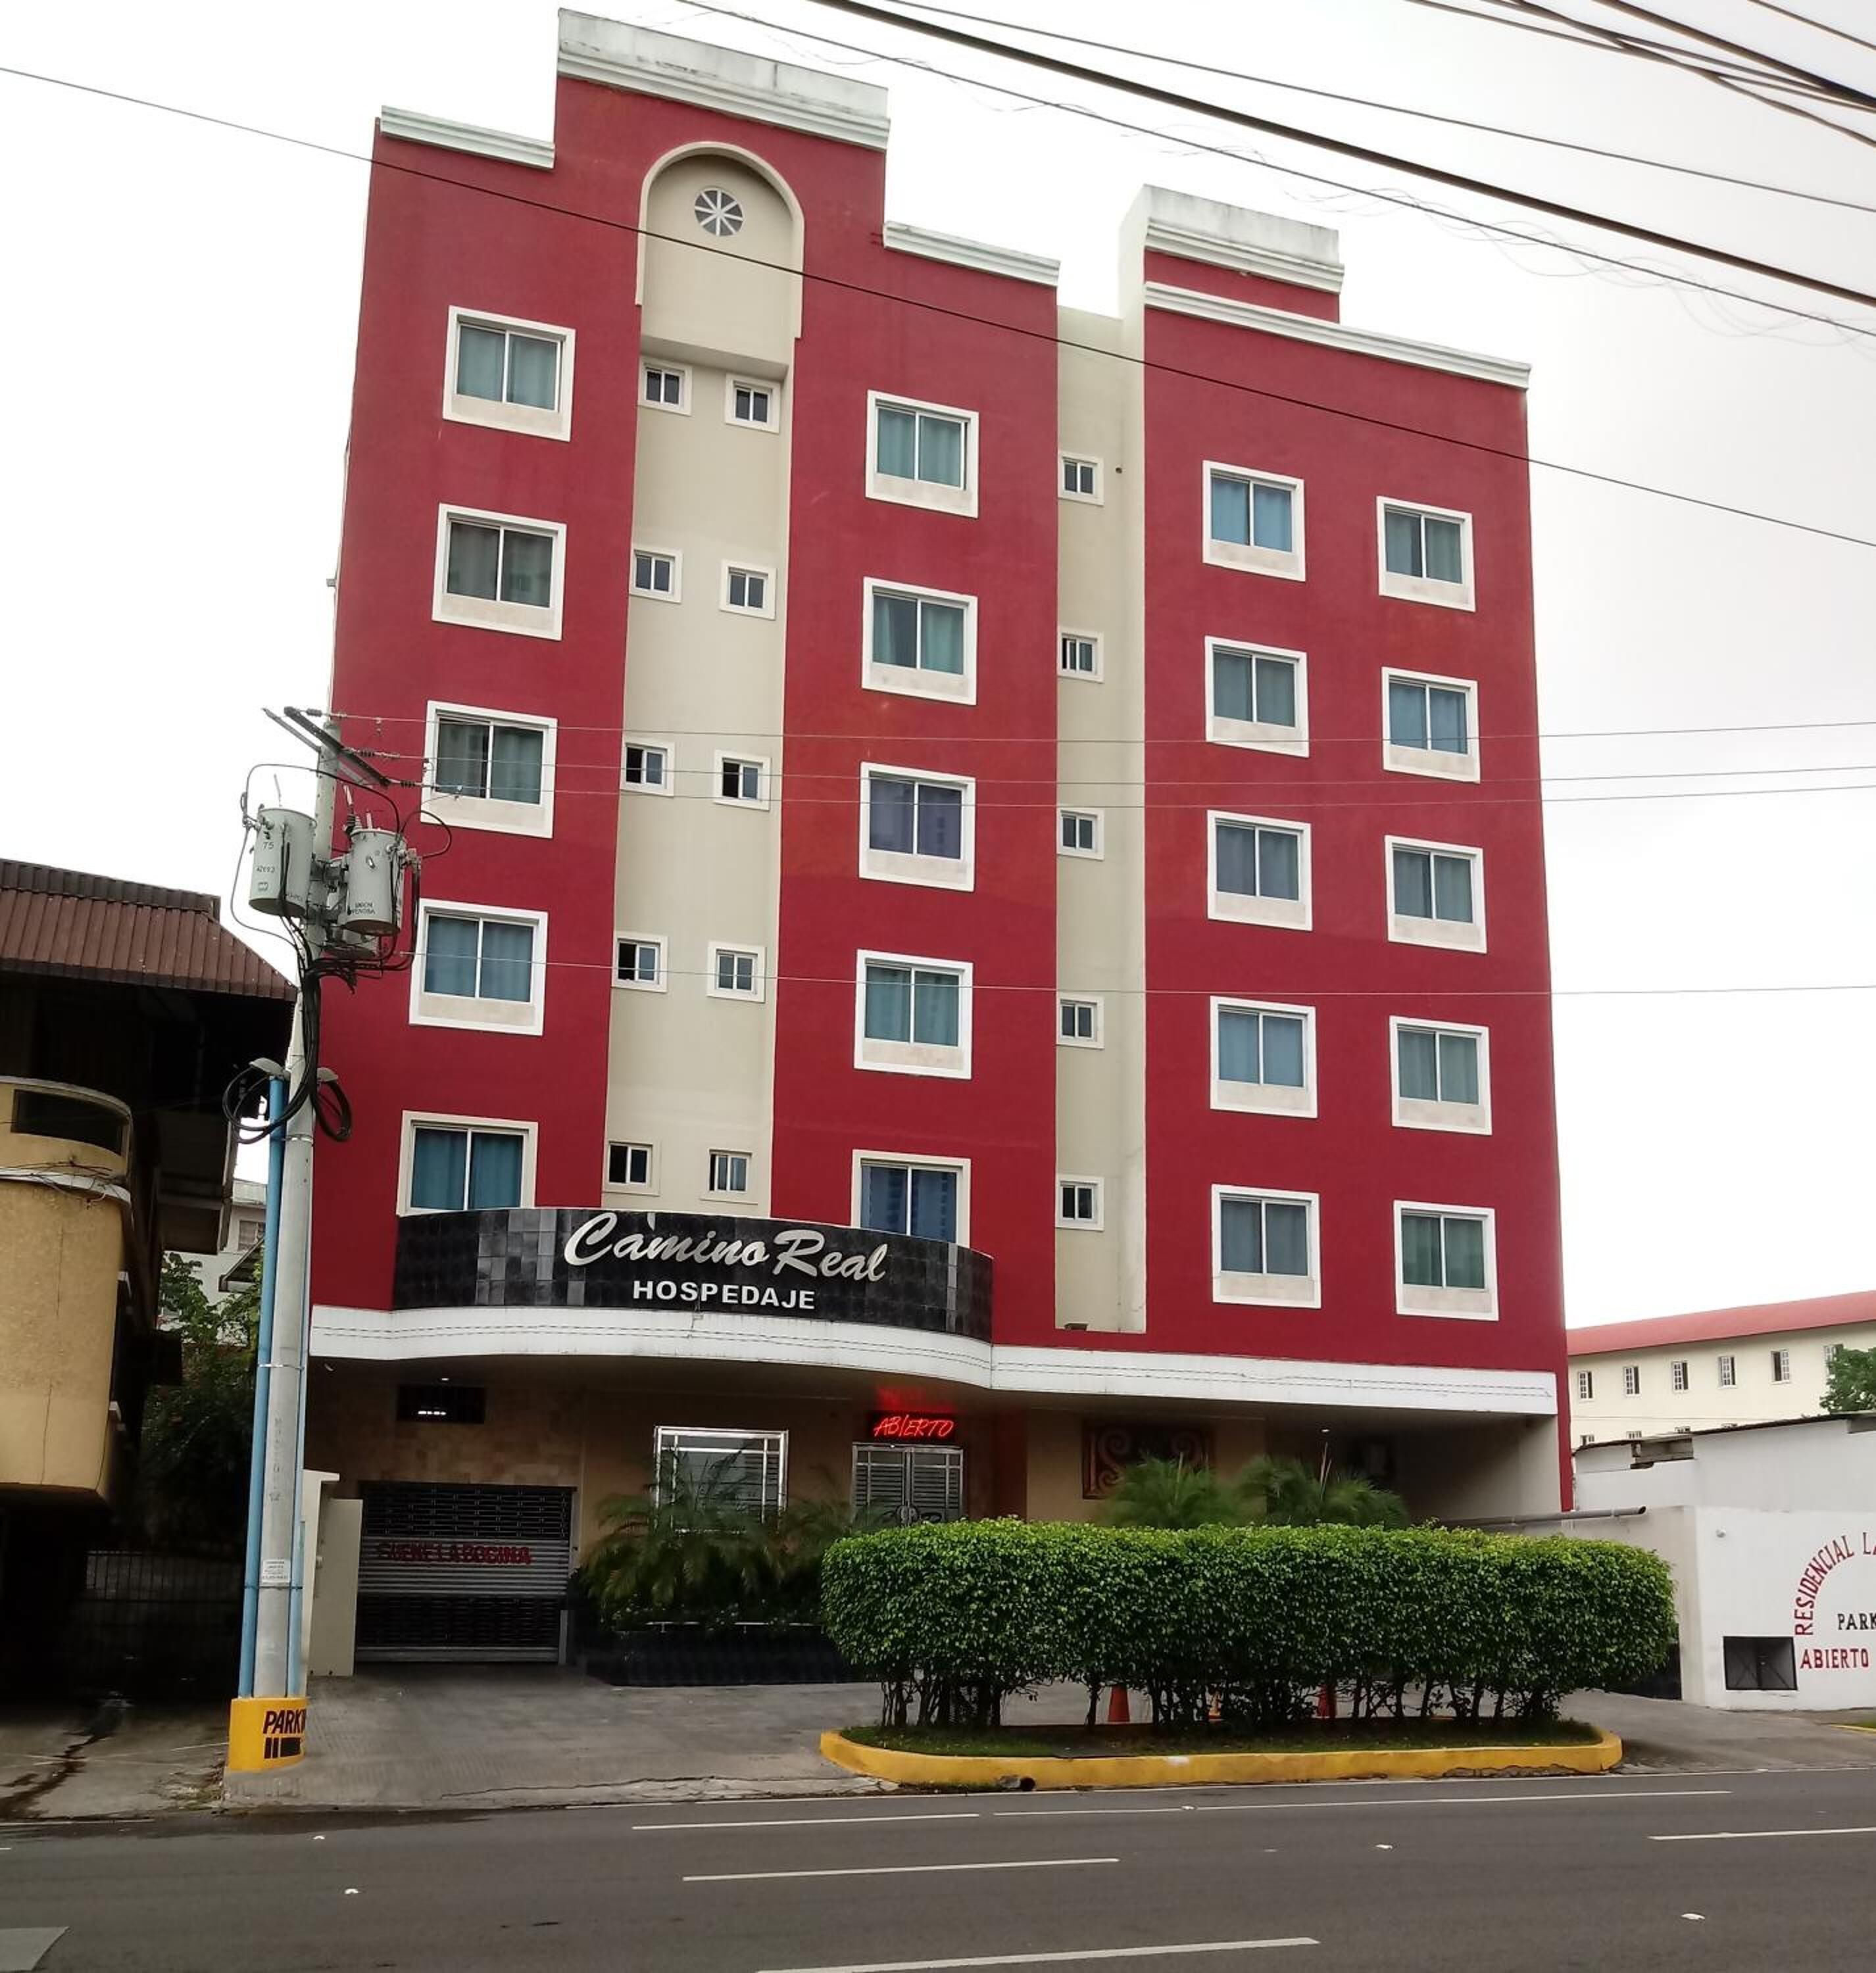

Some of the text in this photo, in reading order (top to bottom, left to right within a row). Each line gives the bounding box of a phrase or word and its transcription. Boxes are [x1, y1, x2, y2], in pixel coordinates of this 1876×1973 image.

[771, 1229, 888, 1281] Real
[633, 1280, 815, 1310] HOSPEDAJE
[873, 1414, 954, 1438] ABIERTO
[1794, 1534, 1854, 1636] RESIDENCIAL
[1800, 1648, 1869, 1669] ABIERTO
